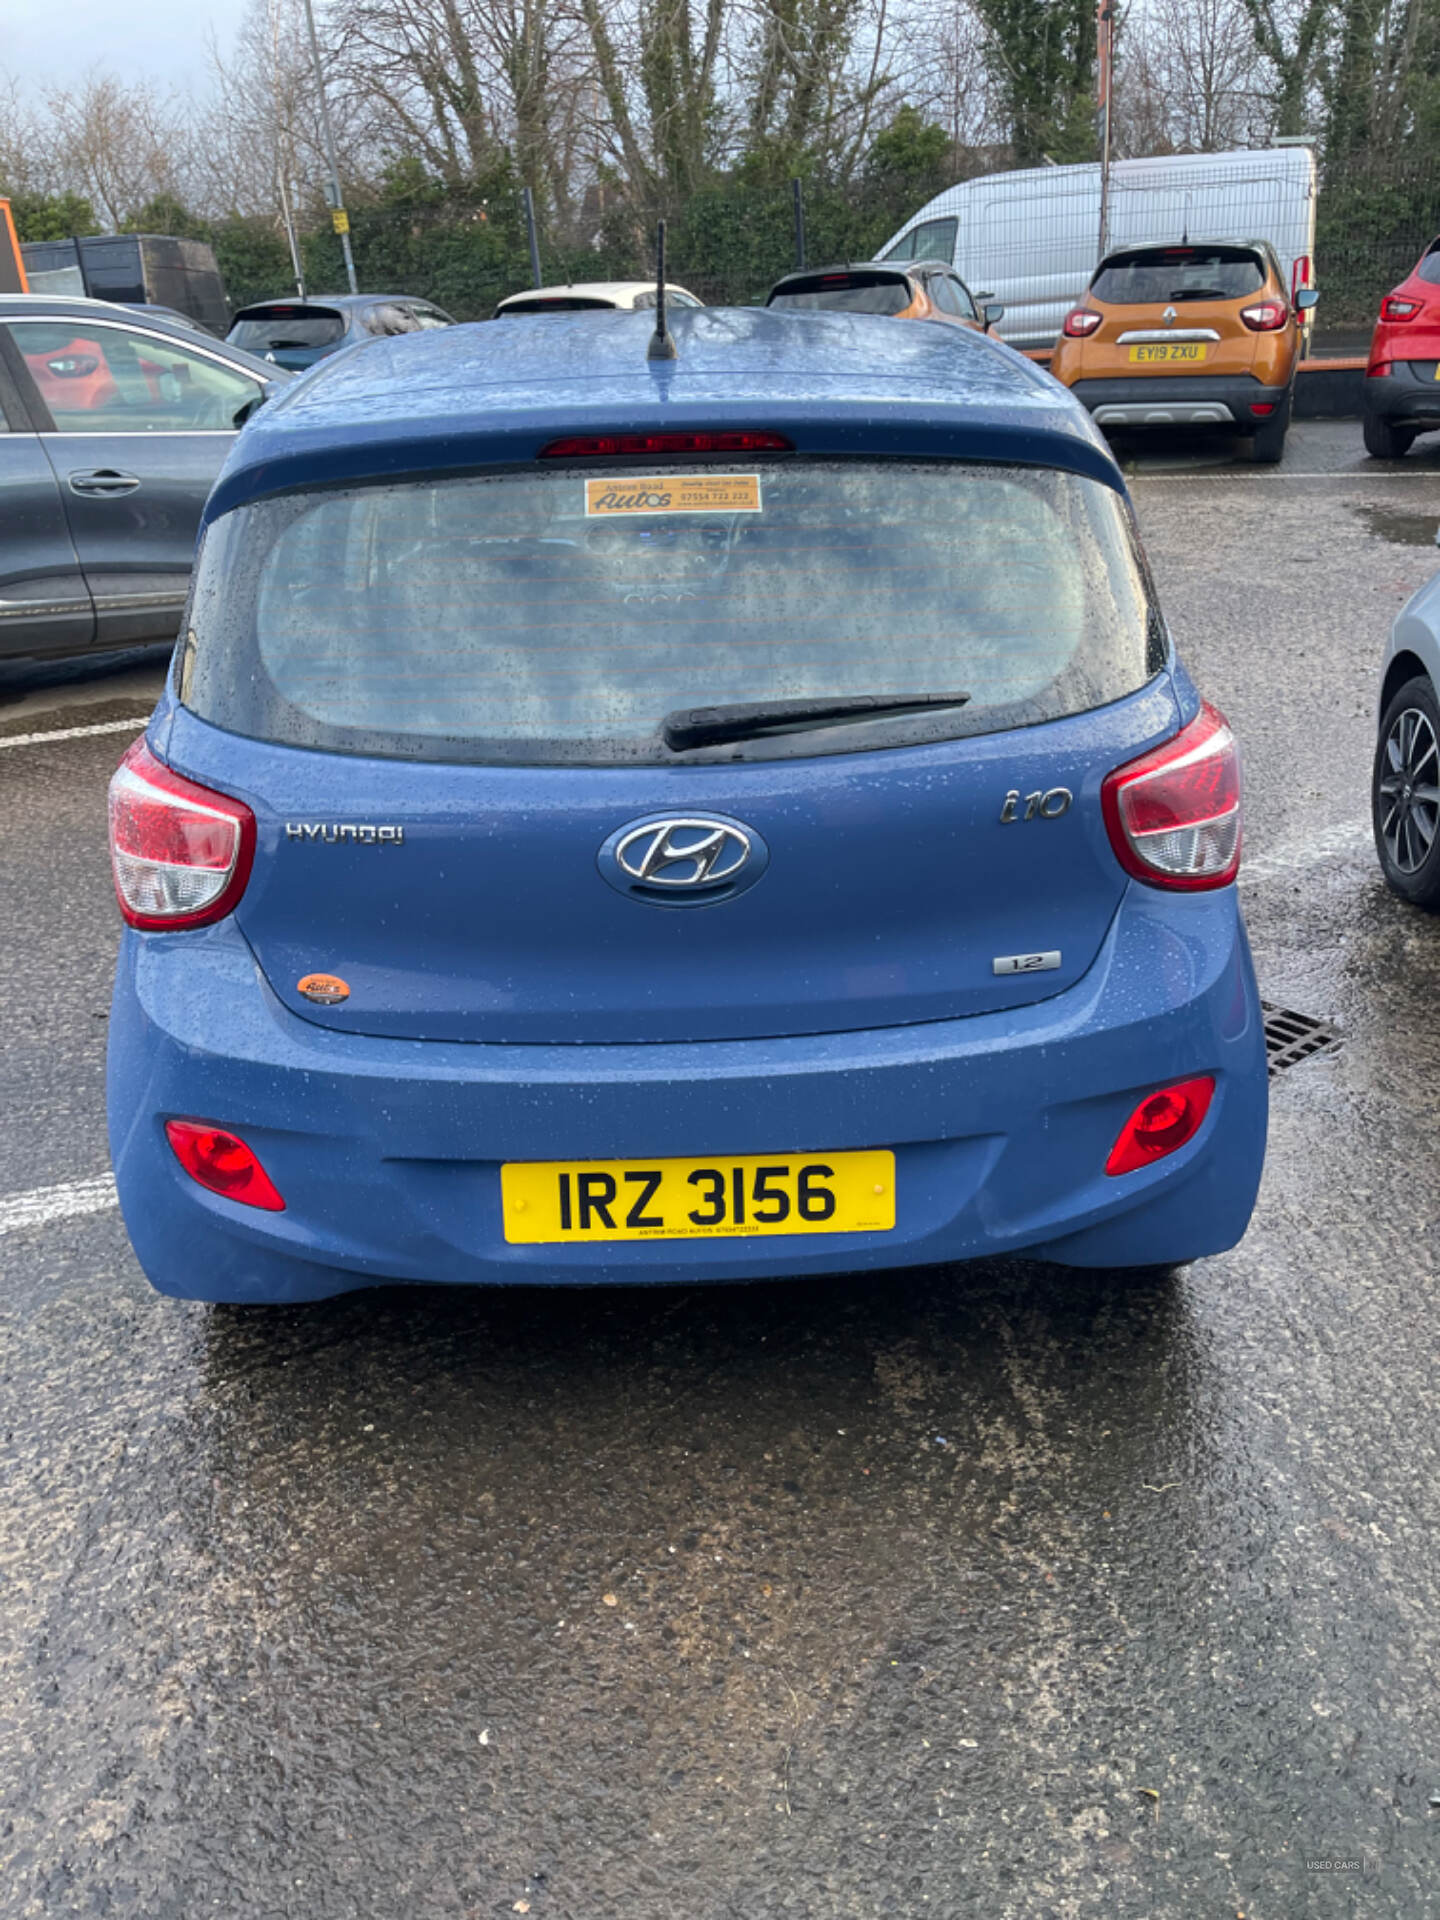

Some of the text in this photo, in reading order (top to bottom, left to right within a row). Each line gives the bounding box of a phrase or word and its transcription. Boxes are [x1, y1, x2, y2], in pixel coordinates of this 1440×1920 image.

[1137, 345, 1199, 360] EY19 ZXU
[593, 491, 672, 510] Autos
[1000, 787, 1073, 824] i10
[286, 822, 404, 846] HYUNDAI
[558, 1164, 836, 1230] IRZ 3156
